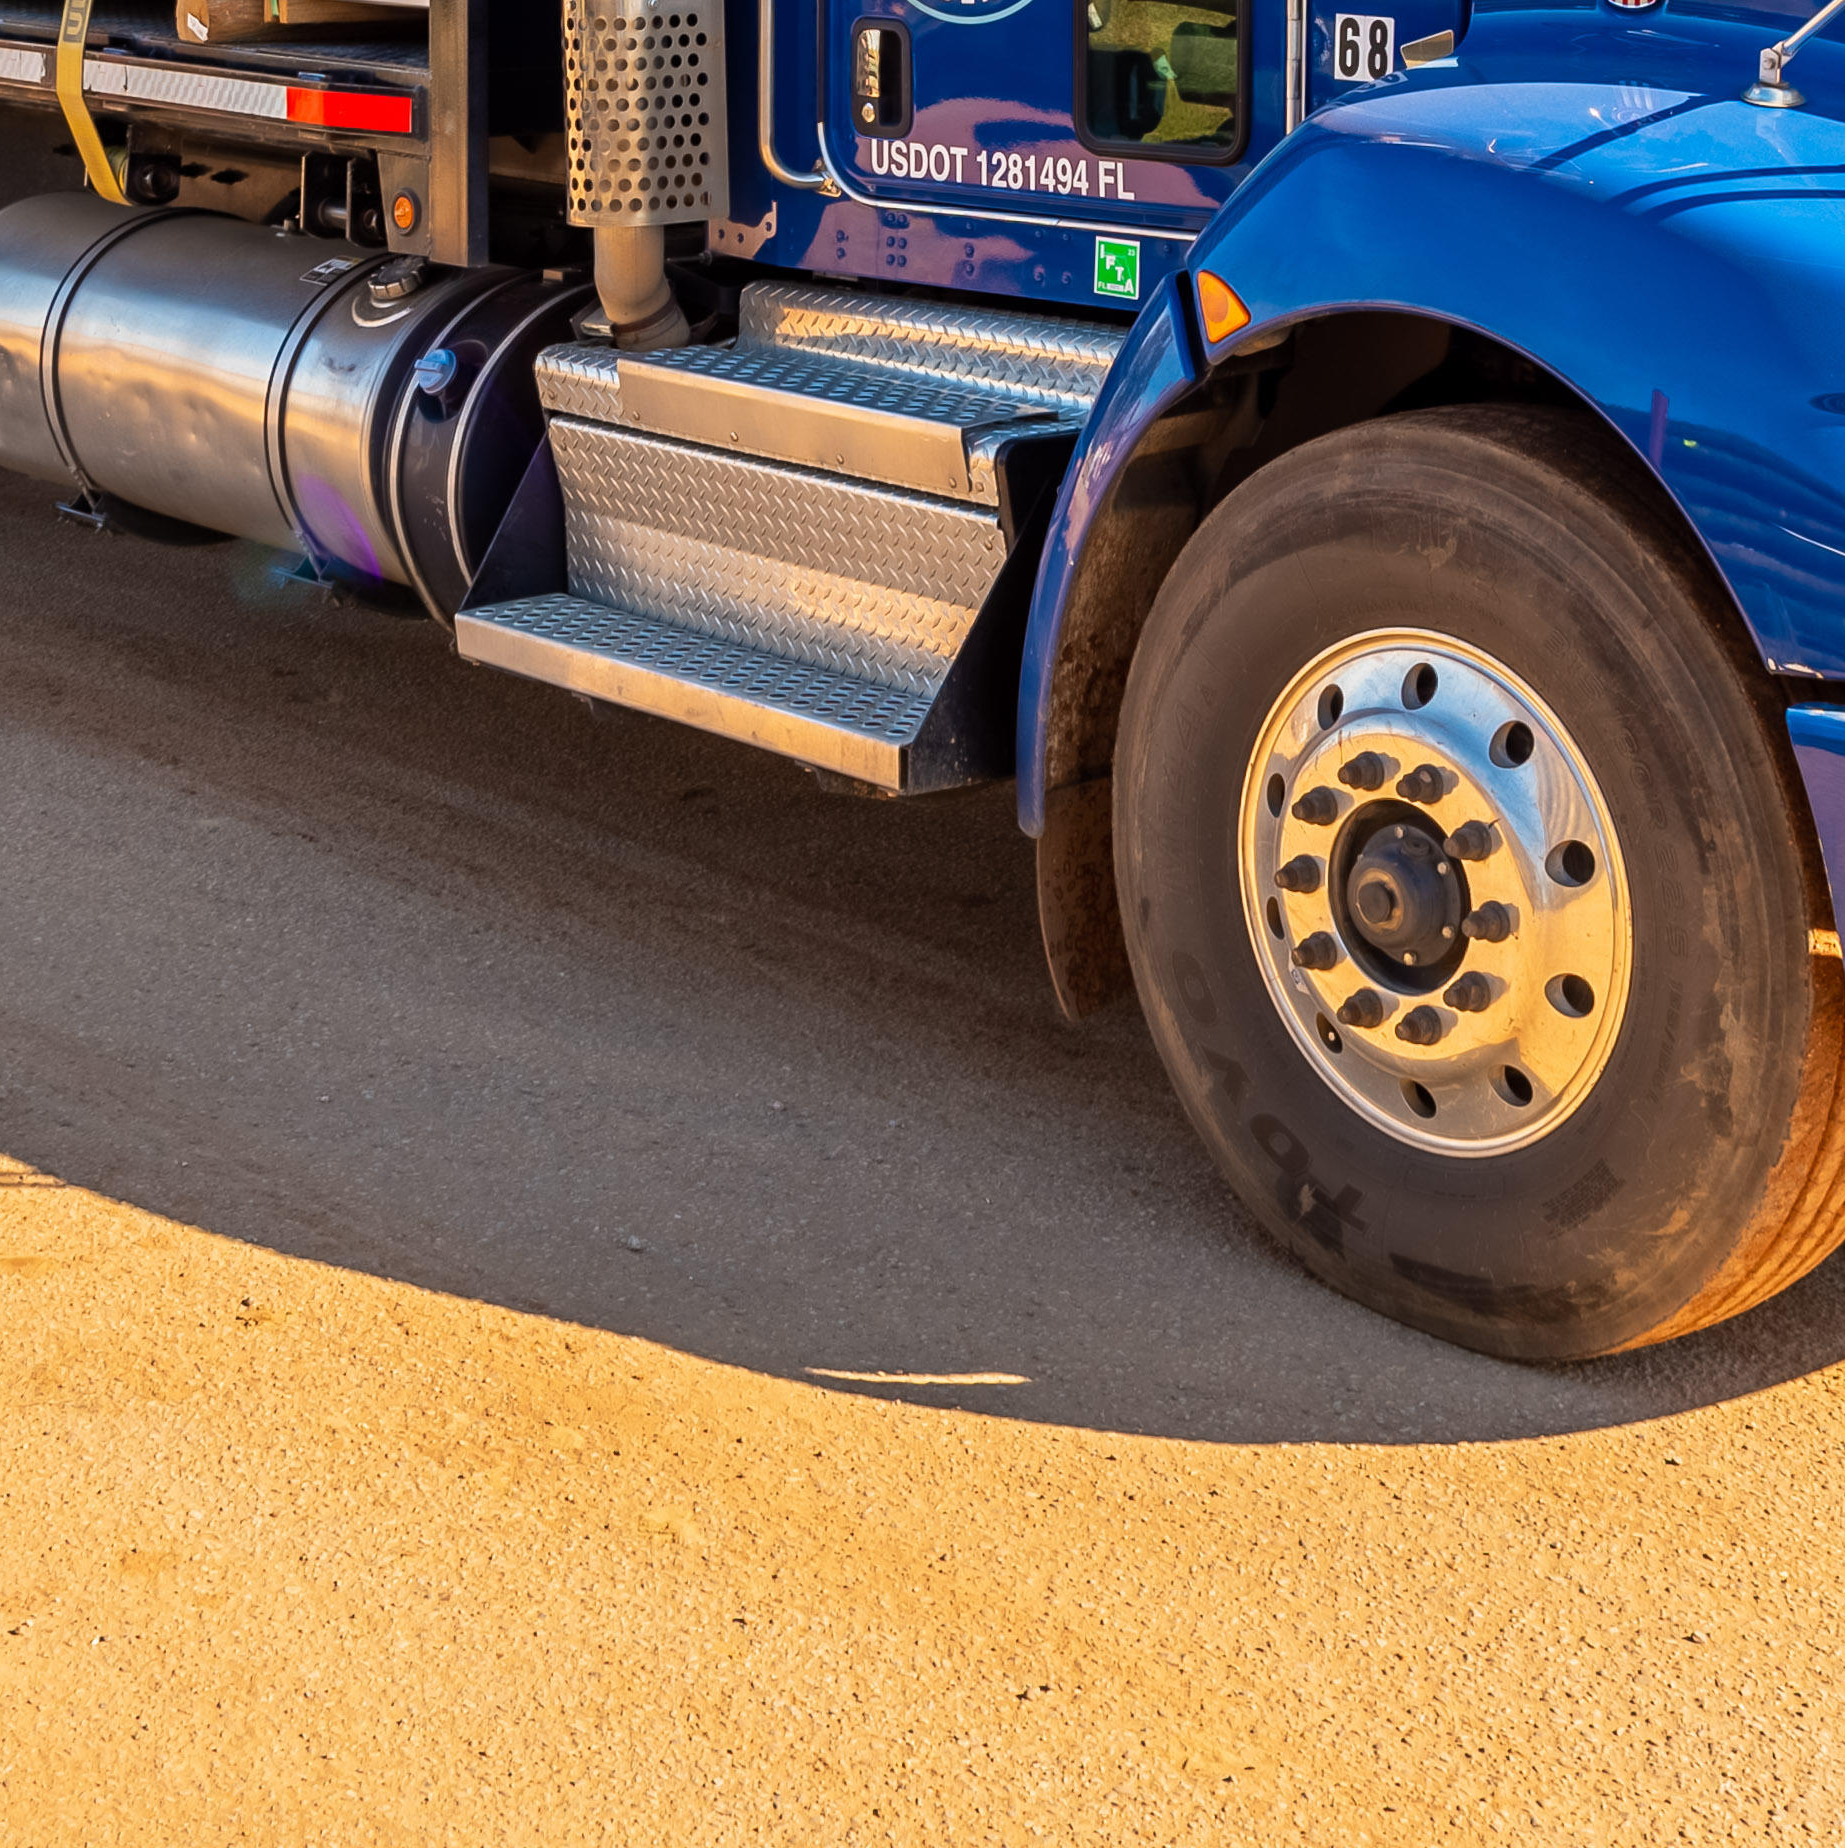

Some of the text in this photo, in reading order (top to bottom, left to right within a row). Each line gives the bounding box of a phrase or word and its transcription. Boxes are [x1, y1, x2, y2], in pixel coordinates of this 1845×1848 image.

[1339, 17, 1388, 80] 68
[871, 138, 1135, 200] USDOT 1281494 FL
